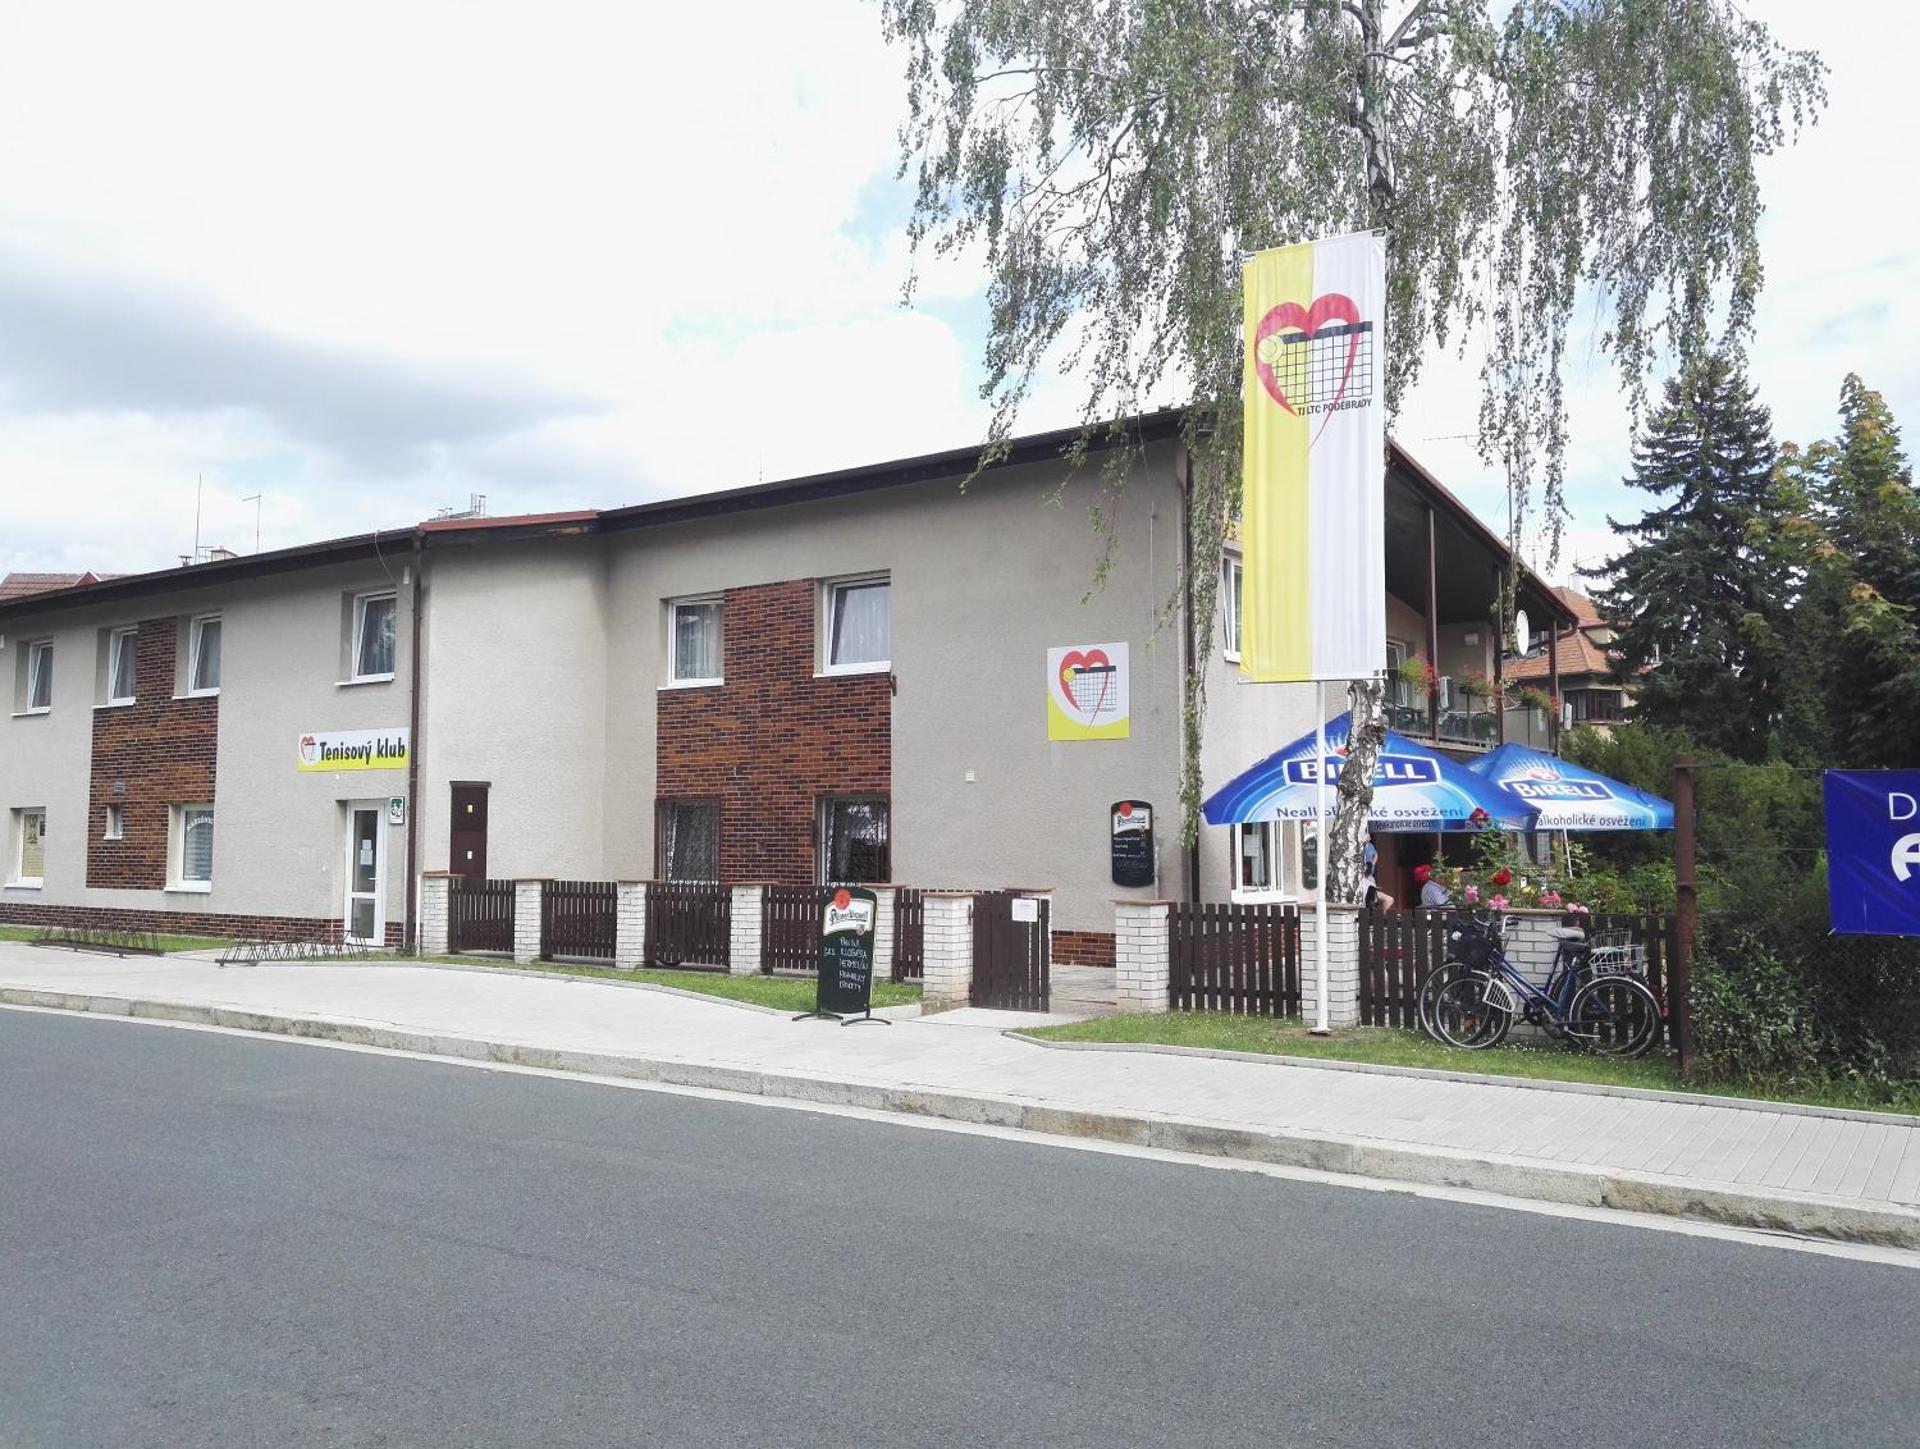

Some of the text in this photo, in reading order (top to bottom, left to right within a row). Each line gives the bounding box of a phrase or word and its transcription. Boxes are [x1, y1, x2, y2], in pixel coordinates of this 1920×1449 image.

[1306, 404, 1321, 415] LTC
[319, 737, 405, 765] Tenisový klub
[1300, 762, 1427, 780] BIELL
[1512, 782, 1606, 798] BIRELL
